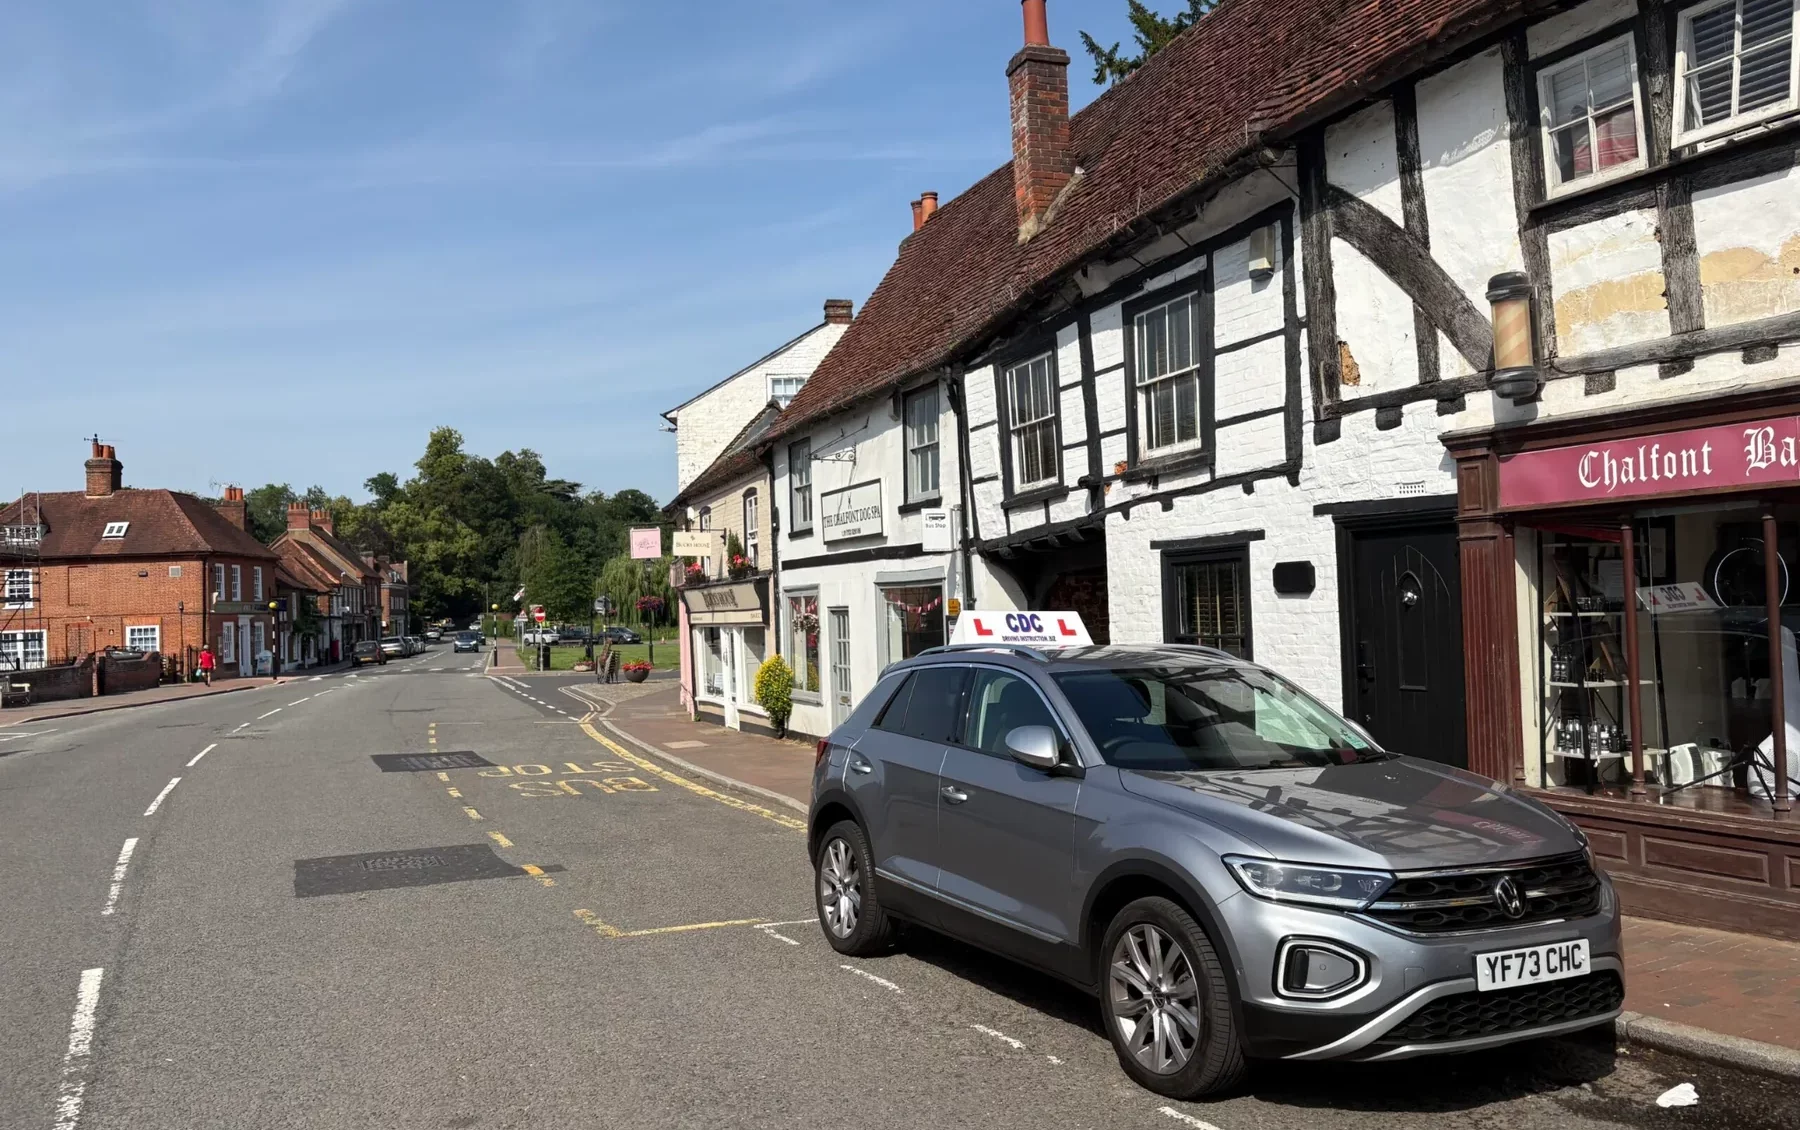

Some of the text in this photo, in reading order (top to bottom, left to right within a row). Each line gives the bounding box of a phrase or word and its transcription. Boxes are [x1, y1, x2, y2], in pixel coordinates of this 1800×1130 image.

[1578, 440, 1713, 493] Chalfont
[834, 509, 860, 526] CHALFONT
[860, 506, 871, 521] DOG
[973, 618, 993, 636] L
[1005, 613, 1044, 633] CDC
[1057, 618, 1077, 636] L
[477, 761, 636, 777] STOP
[509, 776, 660, 797] BUS
[1486, 943, 1583, 984] YF73 CHC
